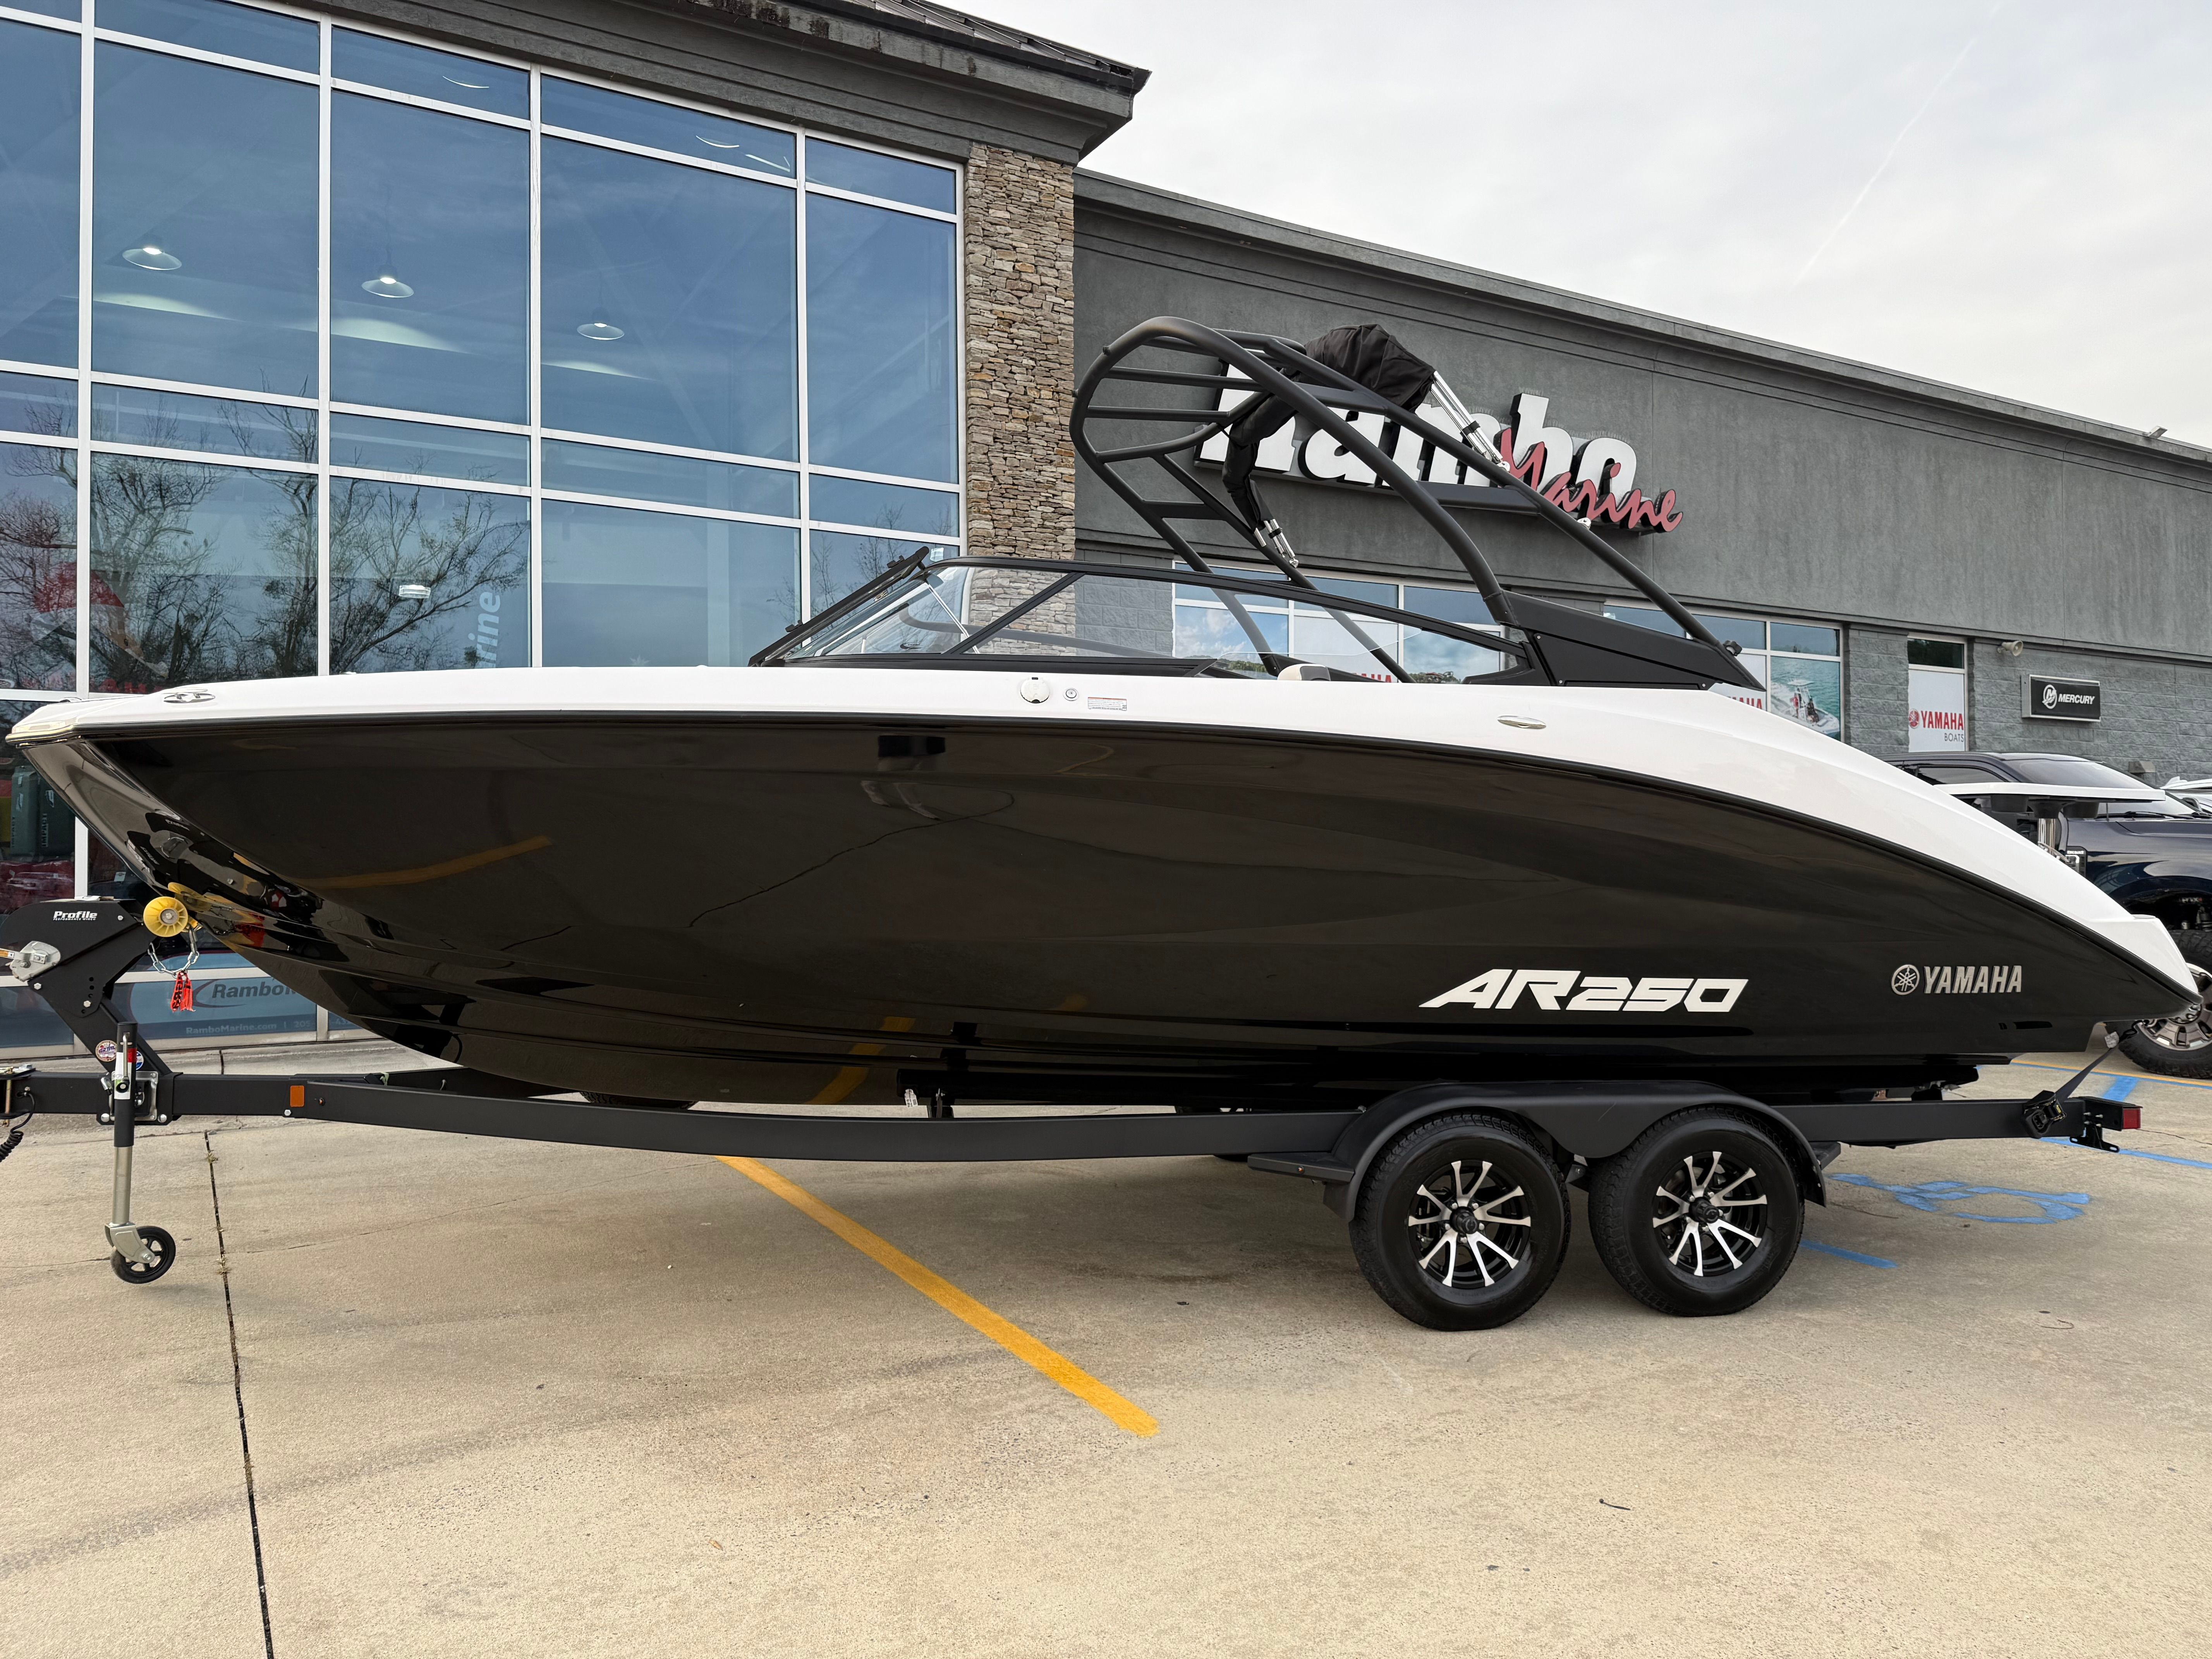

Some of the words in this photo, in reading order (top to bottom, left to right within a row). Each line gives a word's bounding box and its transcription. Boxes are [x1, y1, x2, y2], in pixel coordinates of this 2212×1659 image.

[2058, 694, 2095, 704] MERCURY
[1921, 711, 1964, 730] YAMAHA
[1944, 733, 1964, 742] BOATS
[1924, 965, 2021, 993] YAMAHA
[1419, 969, 1748, 1012] AR250
[186, 1023, 276, 1034] RamboMarine.com
